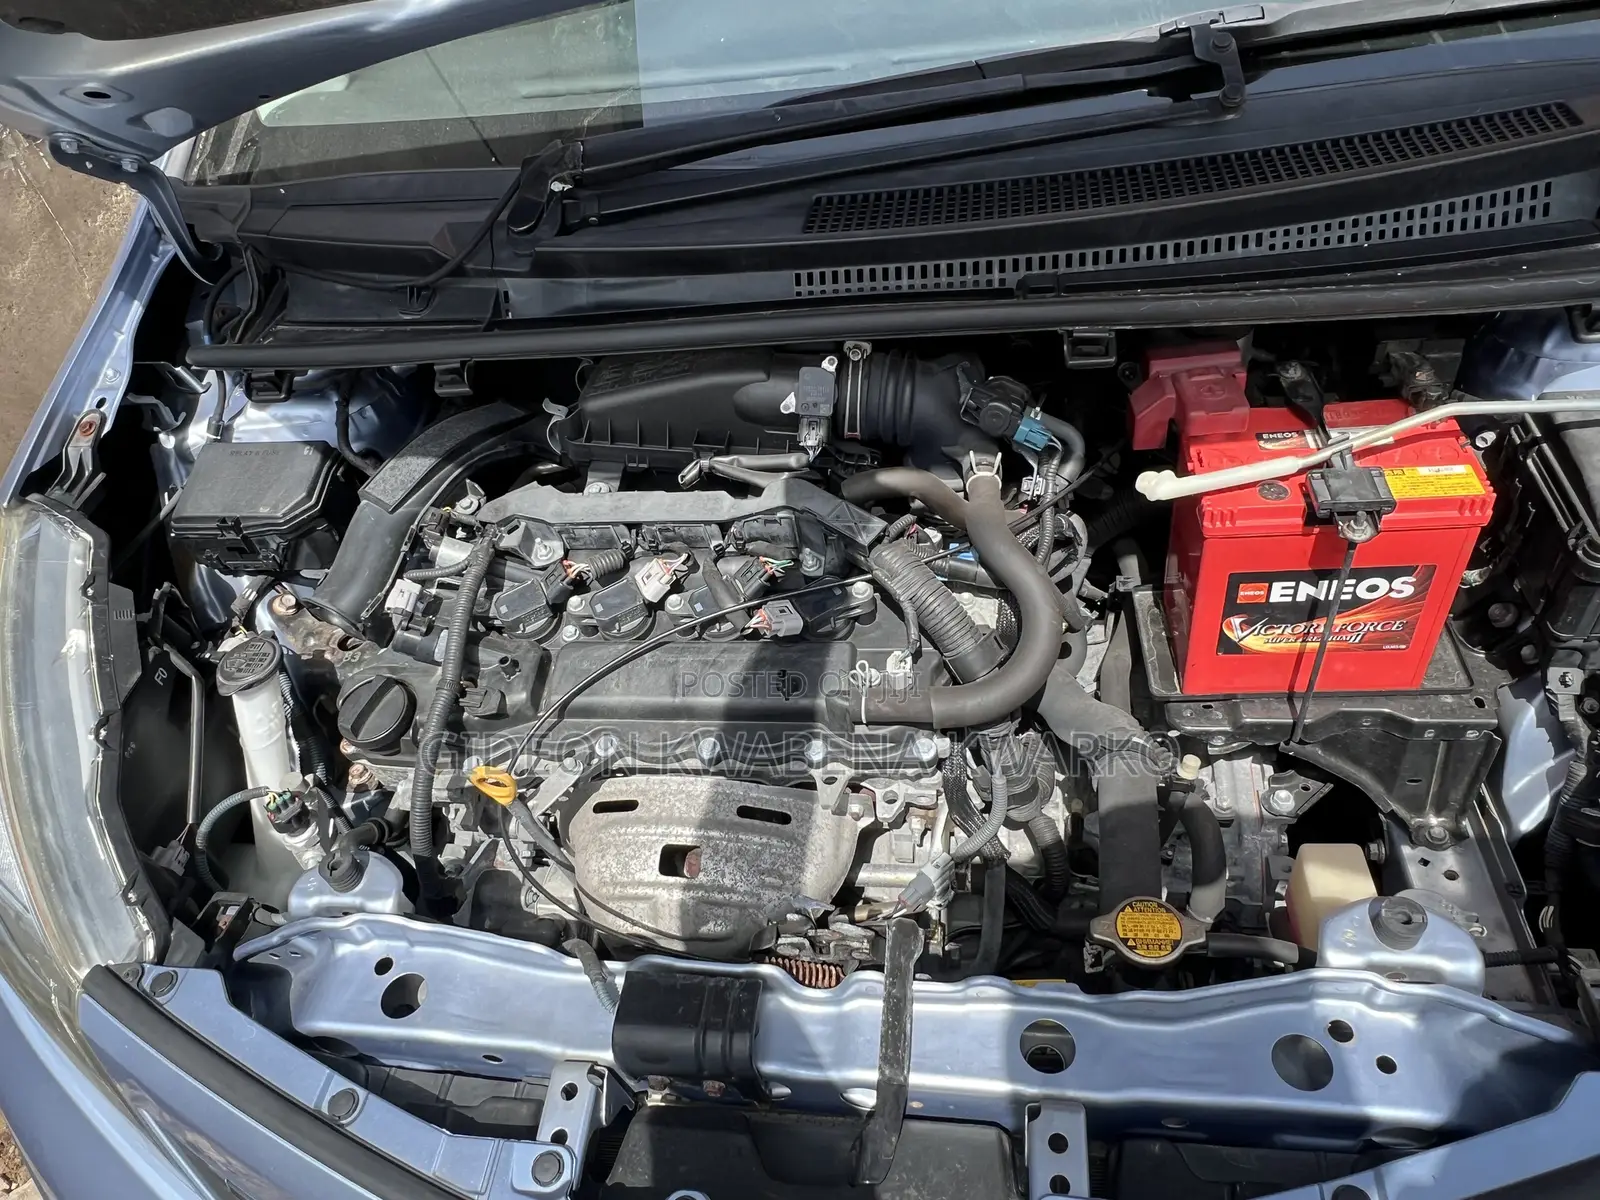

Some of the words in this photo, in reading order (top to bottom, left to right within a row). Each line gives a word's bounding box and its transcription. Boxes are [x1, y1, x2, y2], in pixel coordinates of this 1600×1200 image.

[1262, 432, 1299, 440] ENEOS
[1268, 576, 1417, 604] ENEOS
[1333, 620, 1407, 633] FORCE
